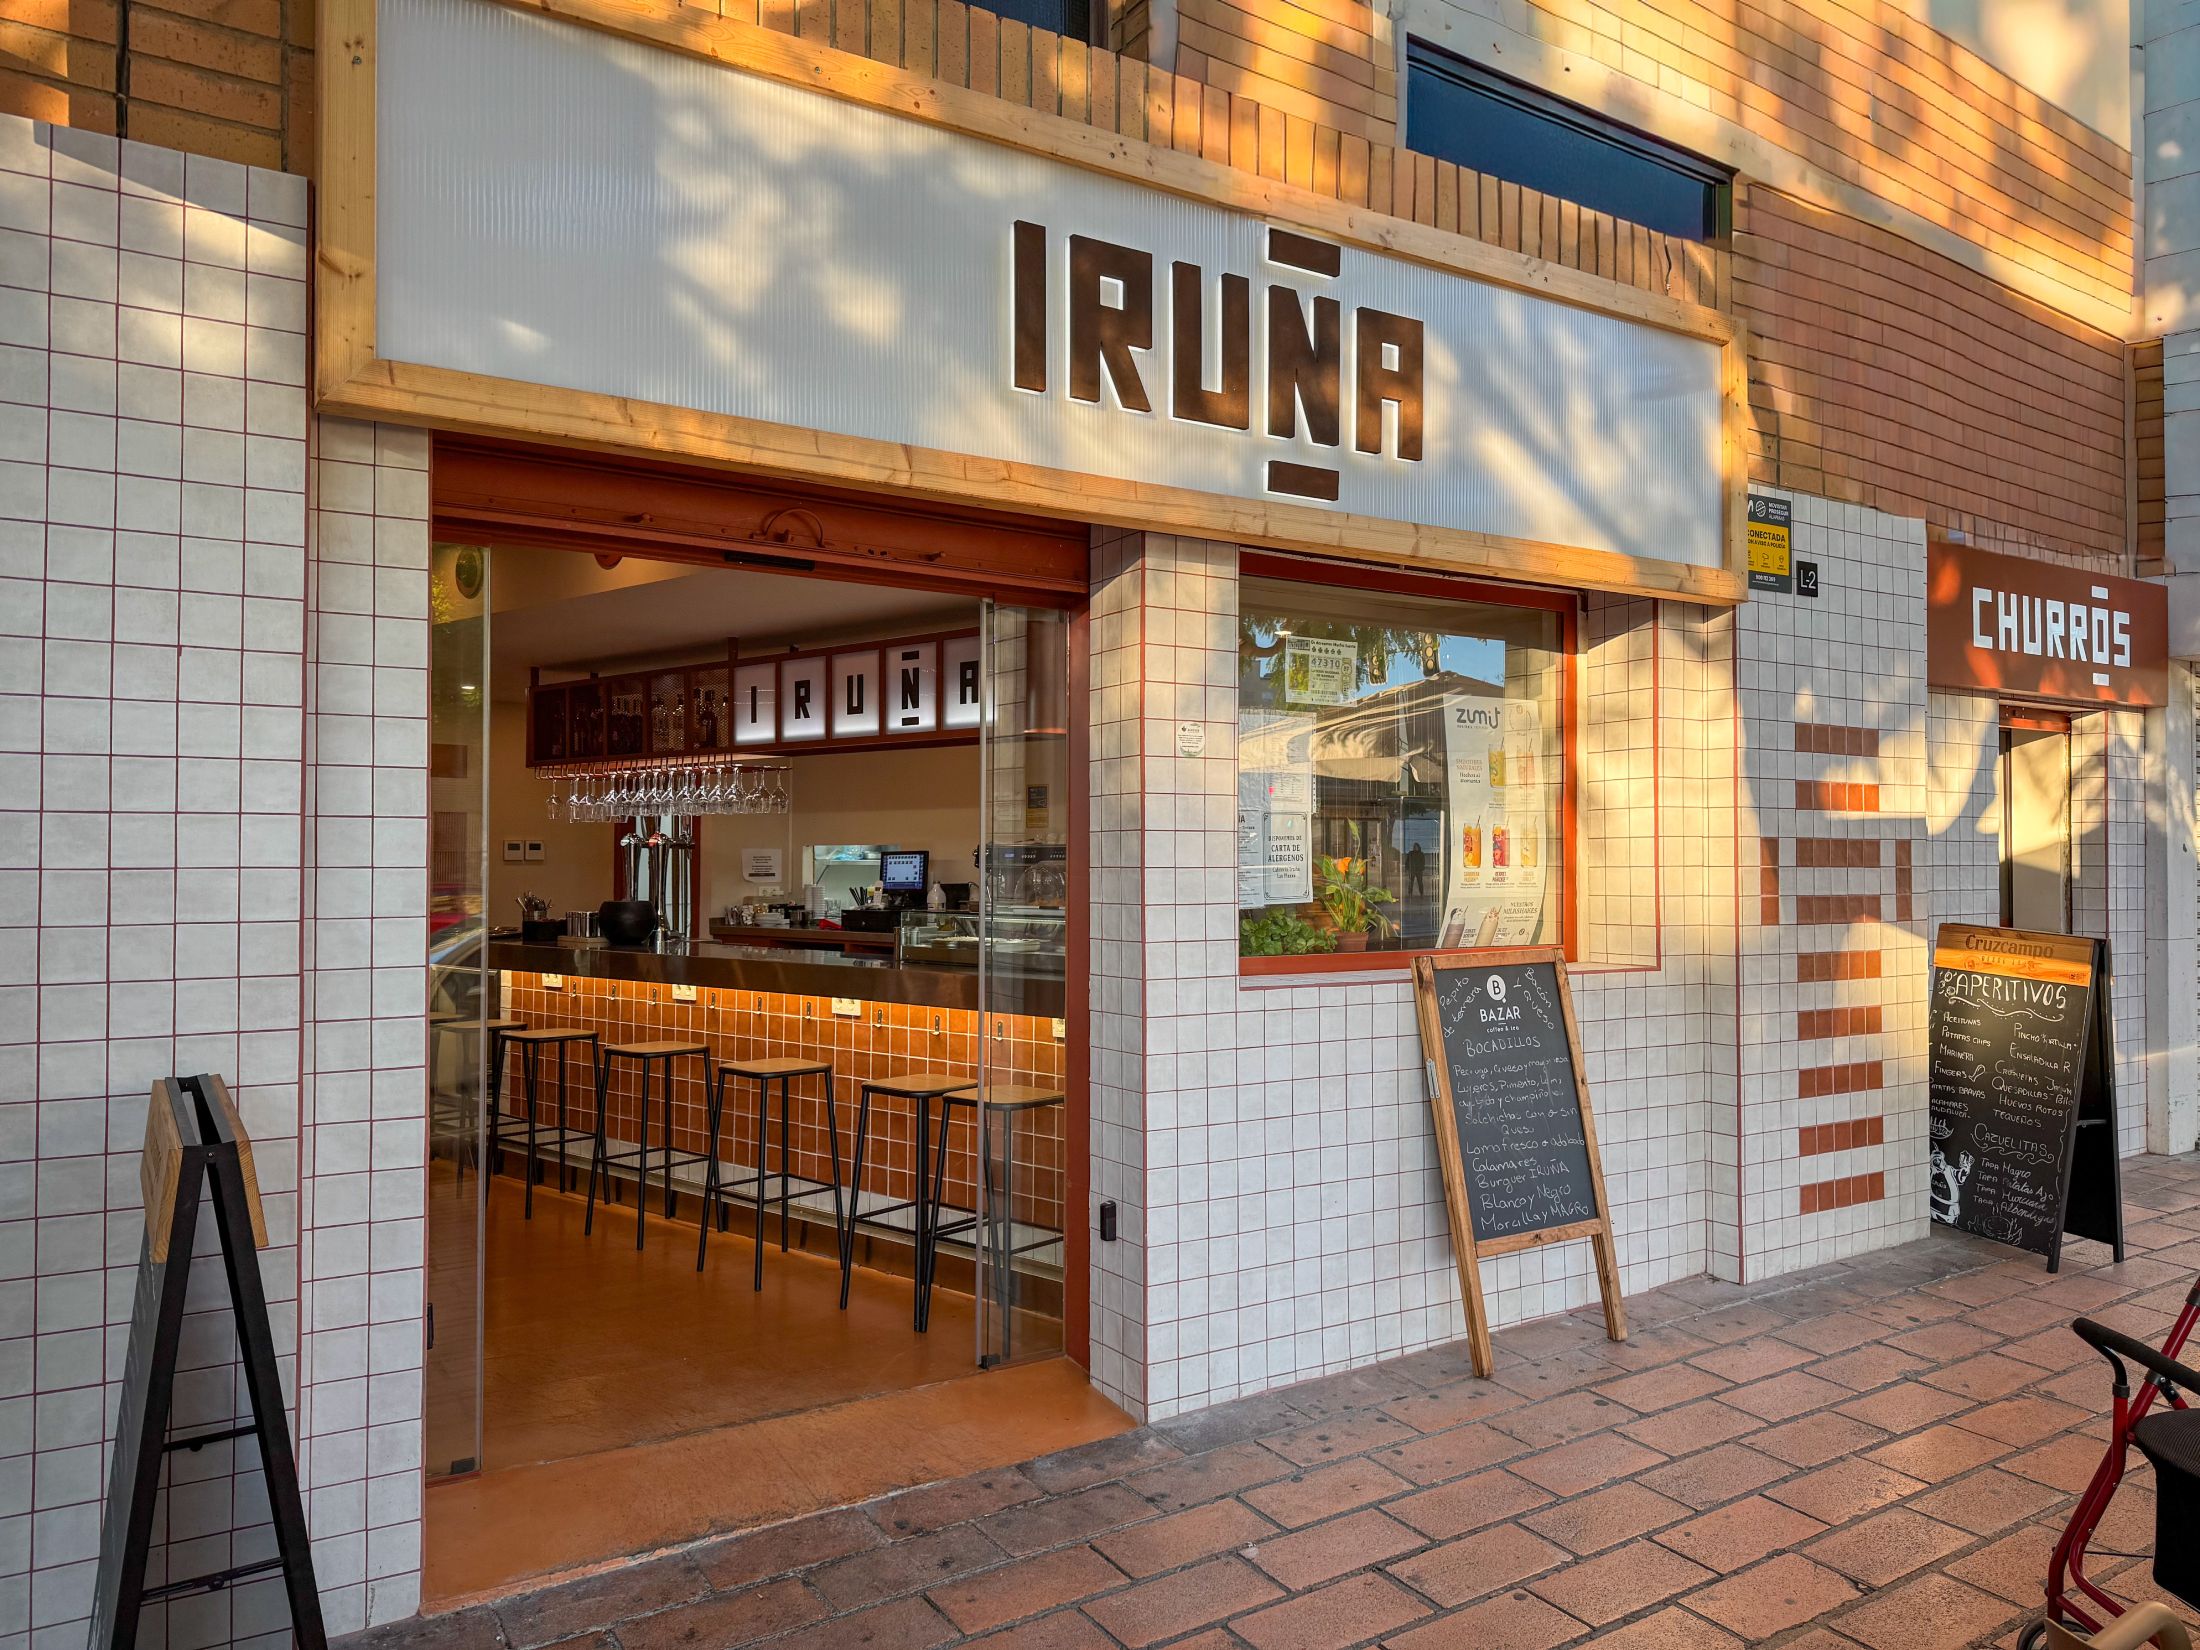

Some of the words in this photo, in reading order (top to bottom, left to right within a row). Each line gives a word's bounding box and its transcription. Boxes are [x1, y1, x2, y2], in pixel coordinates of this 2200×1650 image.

[1010, 222, 1424, 502] IRUÑA
[1800, 570, 1816, 590] L-2
[1965, 934, 2054, 959] Cruzcampo
[1440, 976, 1470, 1010] Pepito
[1956, 974, 2067, 1008] APERITIVOS
[1480, 1006, 1522, 1022] BAZAR
[1463, 1036, 1541, 1056] BOCADILLOS
[1934, 1060, 1968, 1079] FINGERS
[1931, 1098, 1969, 1112] ALAMARES
[2000, 1094, 2032, 1110] HUEVOS
[2036, 1104, 2063, 1117] ROTOS
[1993, 1109, 2042, 1128] TEQUEÑOS
[1466, 1141, 1500, 1155] Lomo
[1974, 1122, 2048, 1157] CAZUELITAS
[1472, 1156, 1537, 1172] Calamares
[1475, 1174, 1526, 1194] Burguer
[1528, 1158, 1570, 1179] IRUÑA
[1480, 1193, 1527, 1211] Blanco
[1537, 1184, 1571, 1204] Negro
[1480, 1211, 1540, 1231] Morcilla
